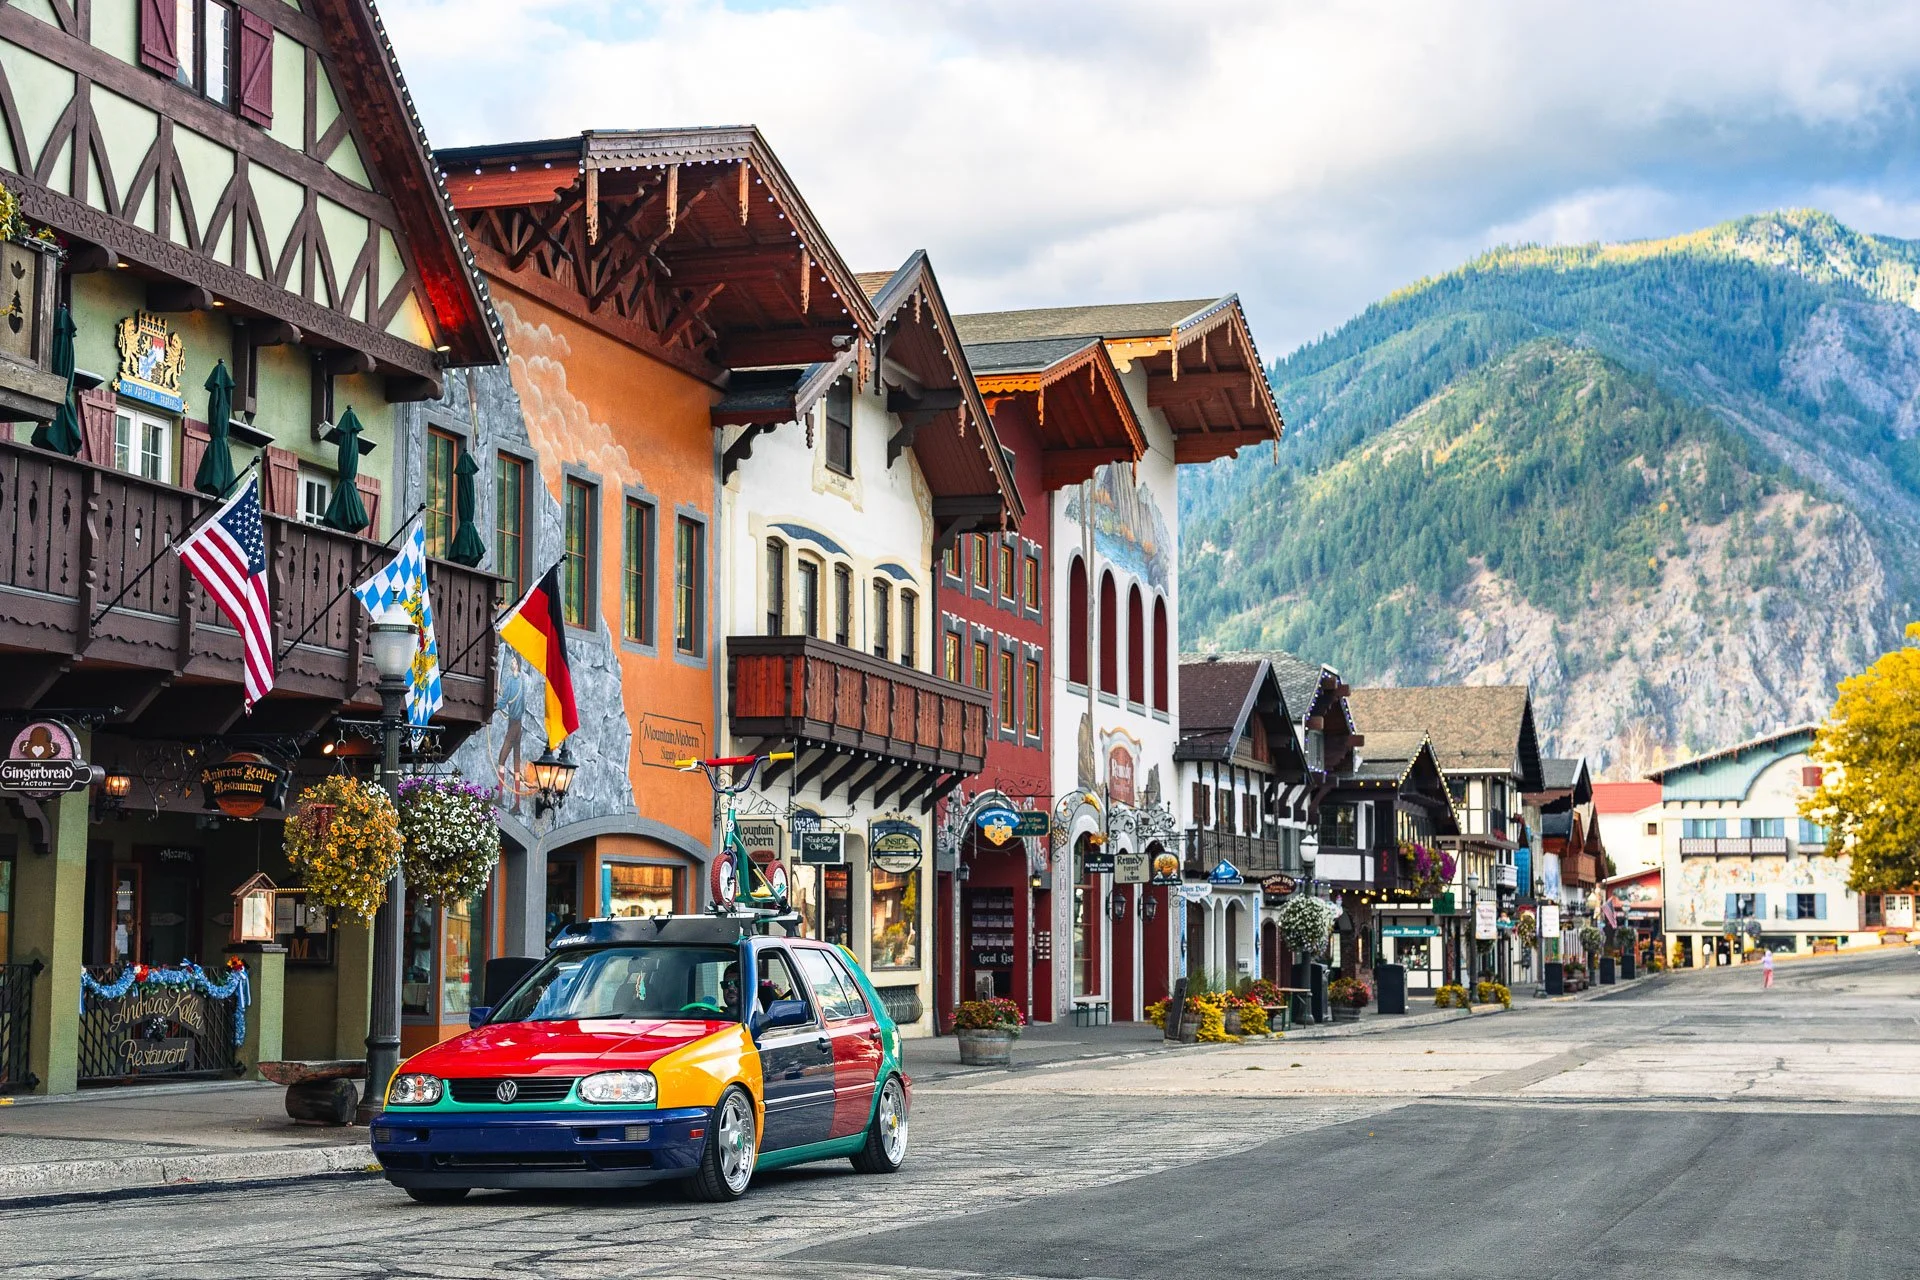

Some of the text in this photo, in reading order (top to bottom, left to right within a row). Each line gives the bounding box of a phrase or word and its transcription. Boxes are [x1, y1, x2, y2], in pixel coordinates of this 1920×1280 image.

[644, 724, 700, 748] Mountain Modern
[2, 766, 73, 781] Gingerbread
[201, 763, 278, 783] Andreas Keller
[1111, 758, 1132, 782] Remedy
[212, 780, 263, 794] Restaurant
[739, 825, 774, 837] ountain
[885, 838, 909, 846] INSIDE
[1117, 853, 1145, 866] Remedy
[290, 938, 310, 959] M
[556, 936, 587, 947] THULE
[110, 988, 204, 1033] Andreas Keller
[119, 1039, 189, 1066] Restaurant
